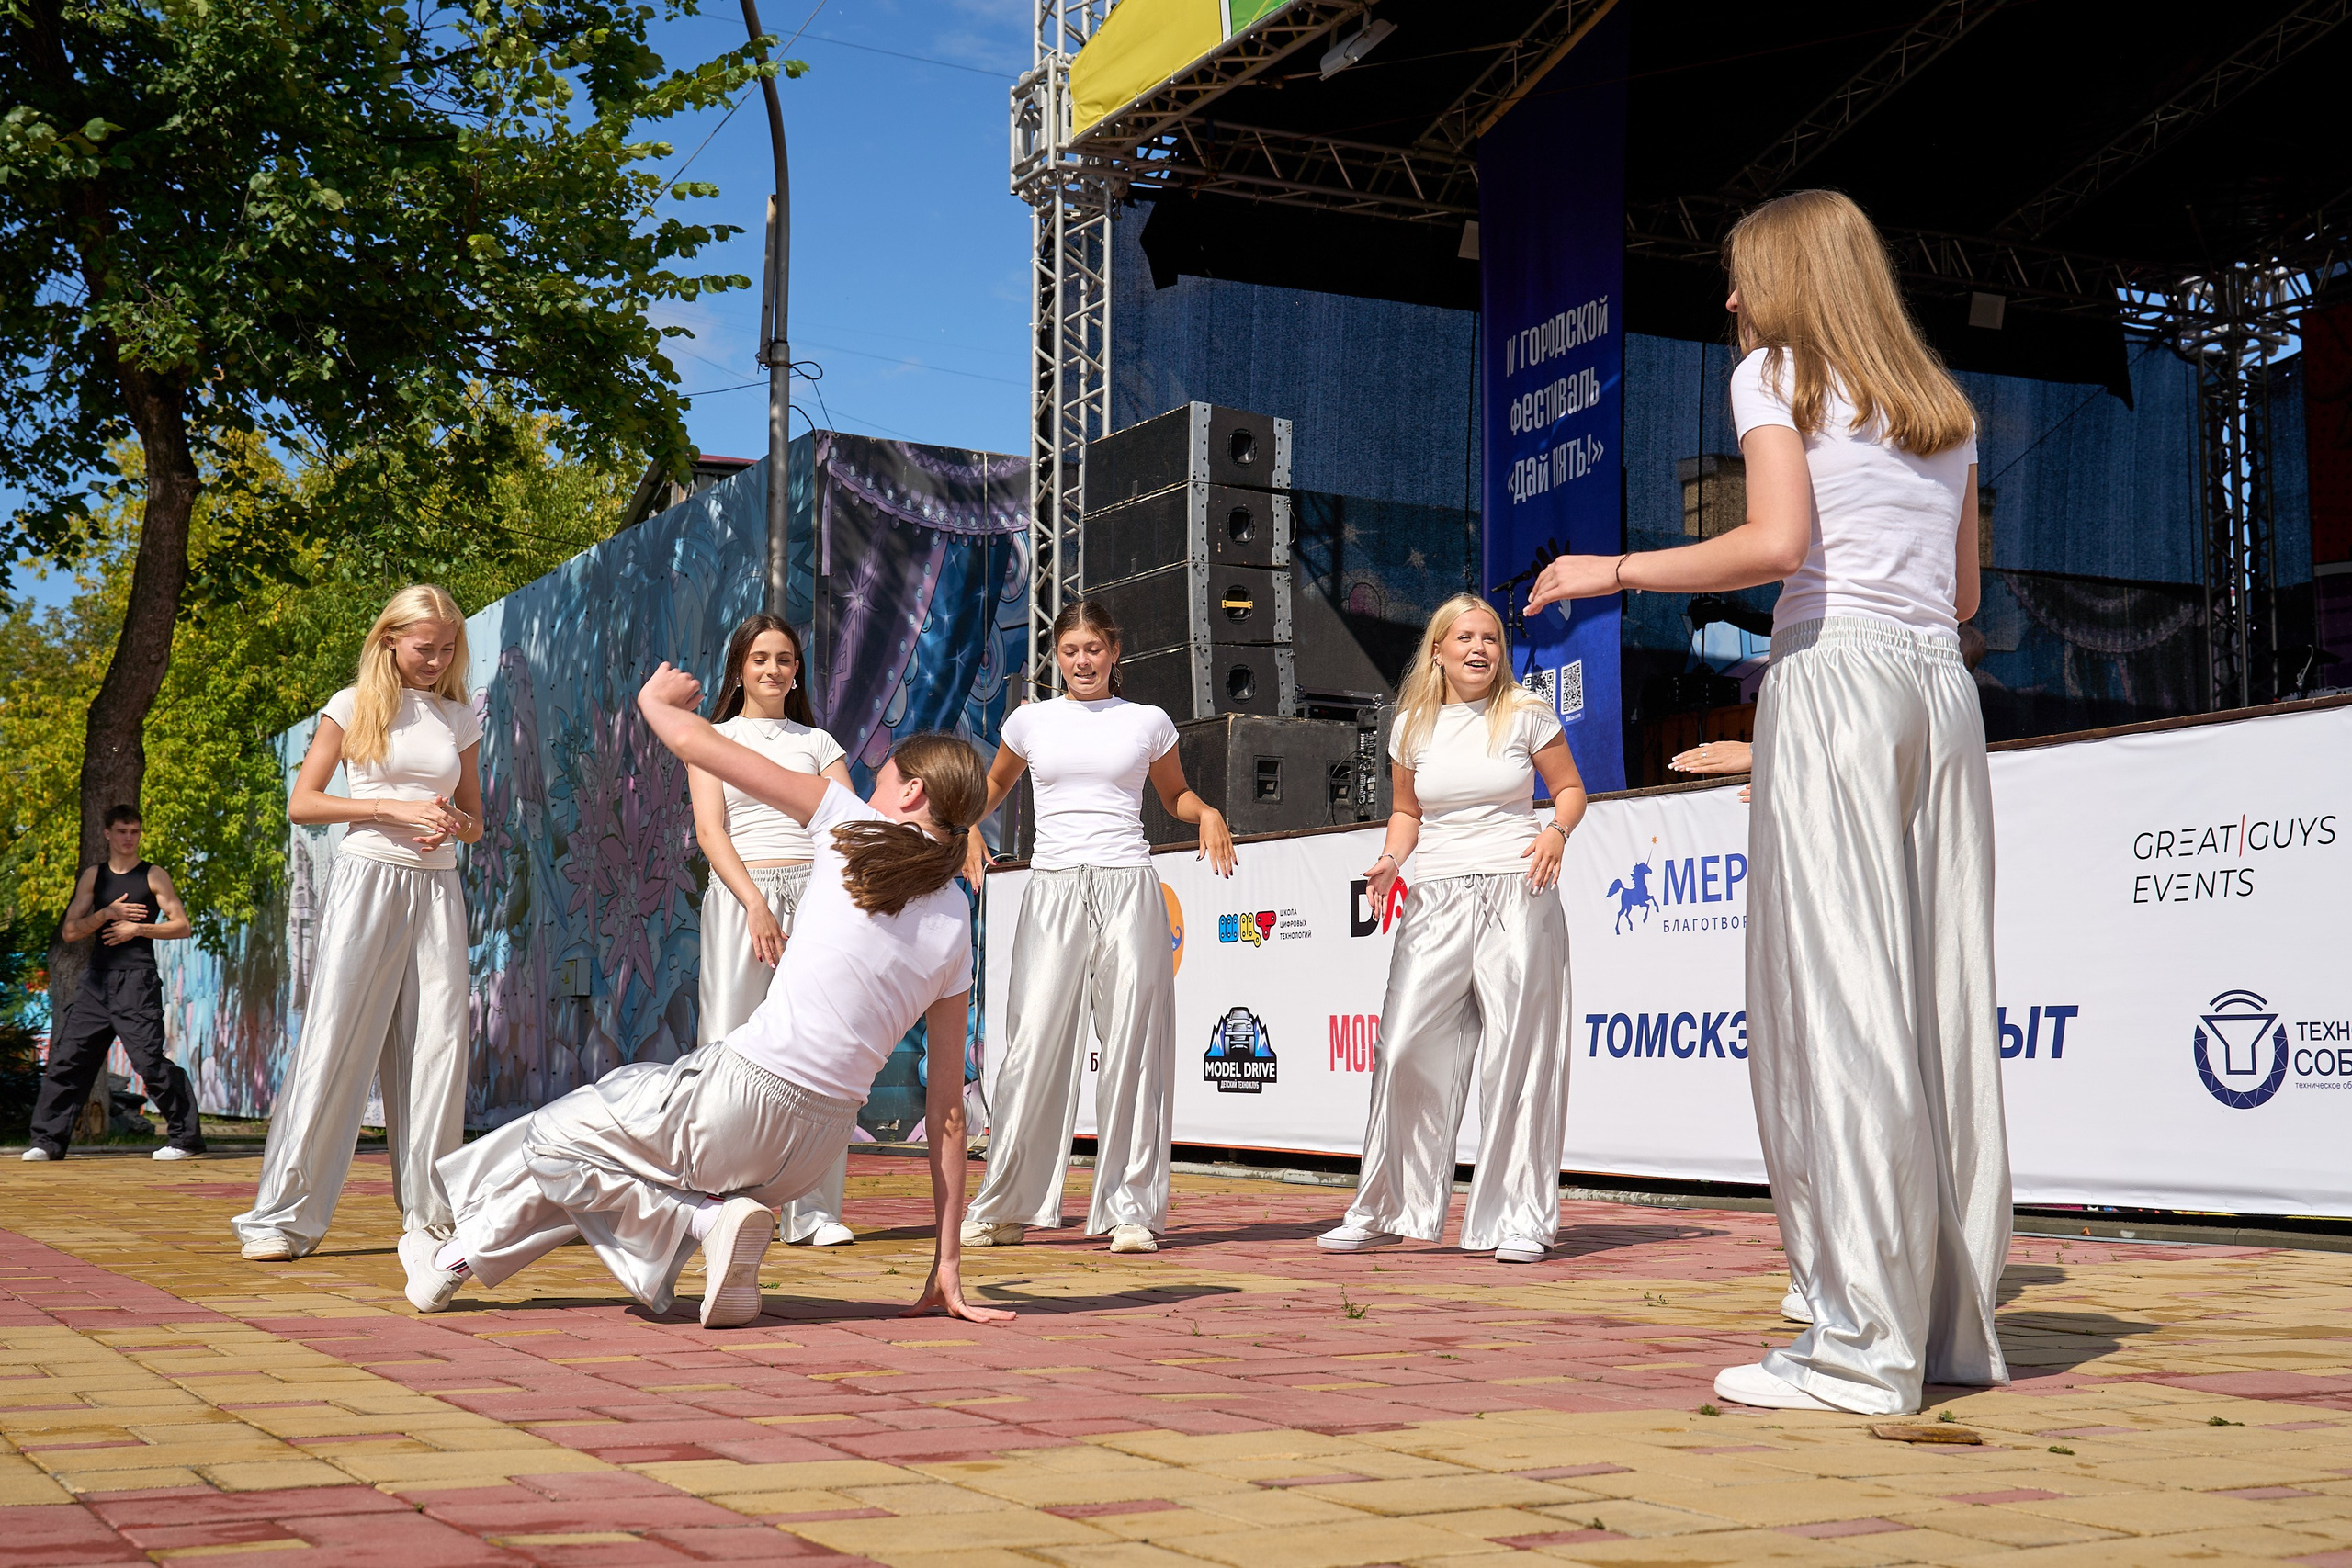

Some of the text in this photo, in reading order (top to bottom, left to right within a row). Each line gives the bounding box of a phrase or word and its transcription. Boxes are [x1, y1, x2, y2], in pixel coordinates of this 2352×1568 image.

[2133, 867, 2255, 904] EVENTS
[1205, 1061, 1275, 1078] MODEL DRIVE
